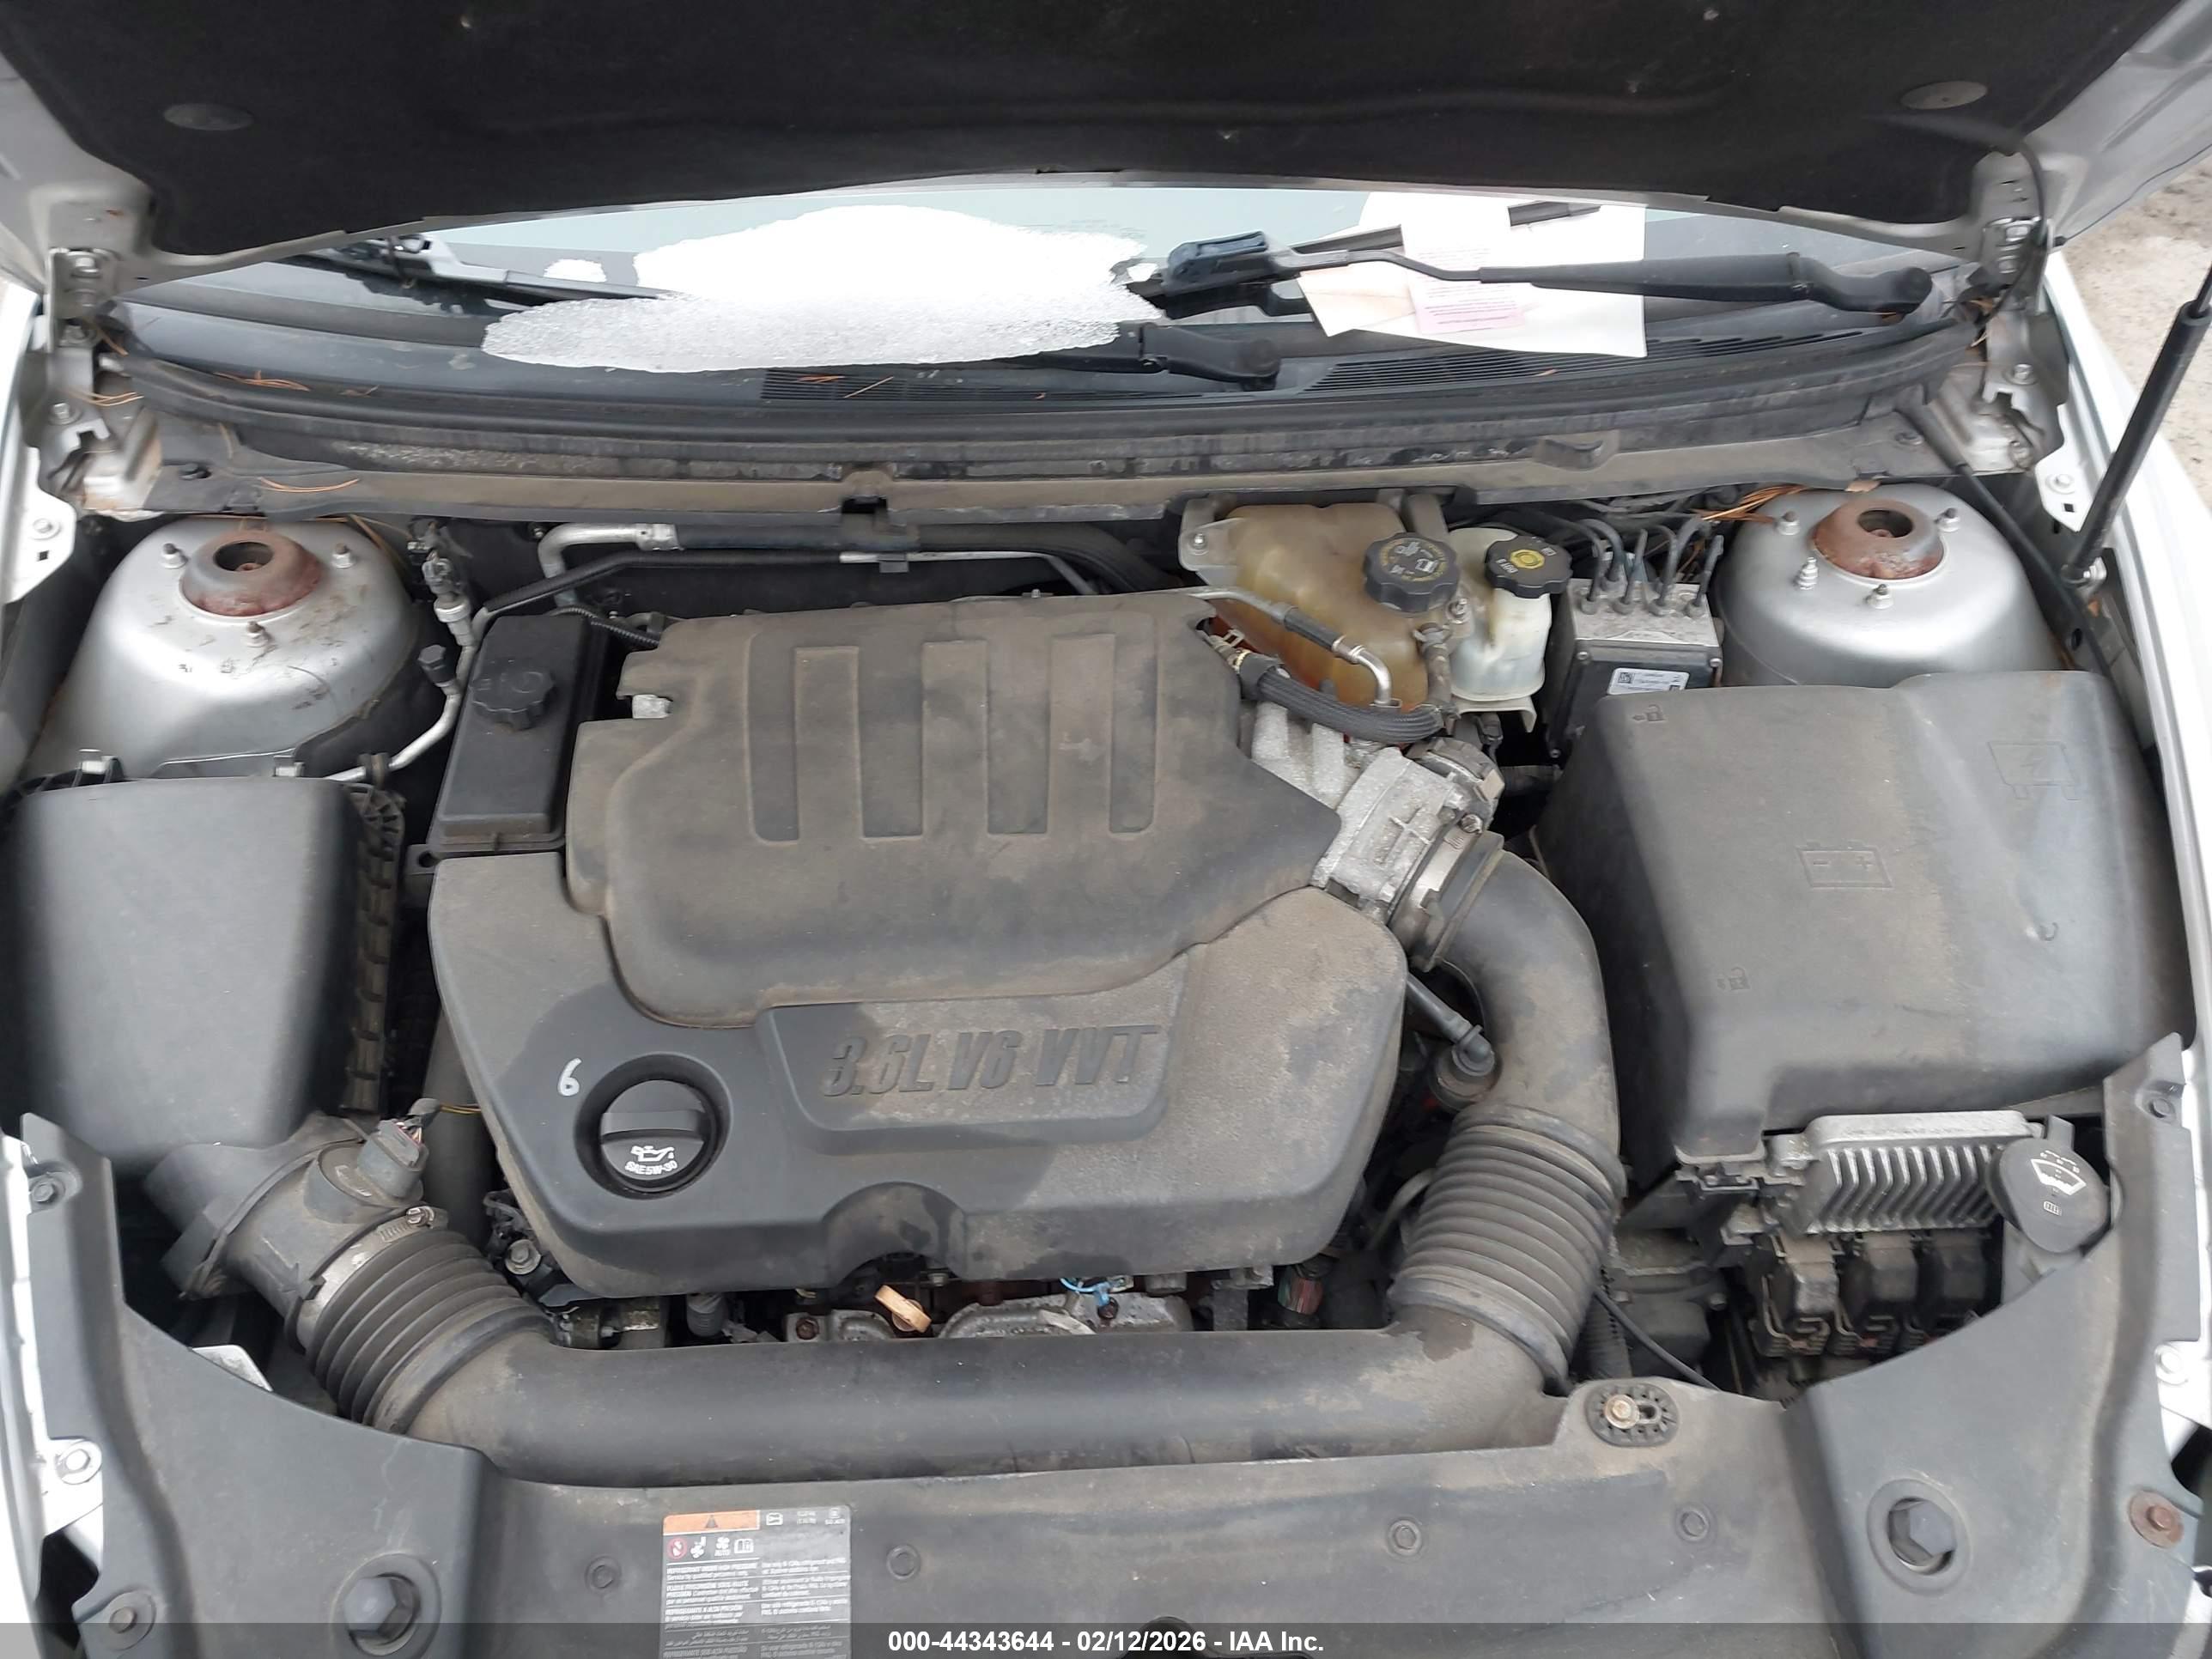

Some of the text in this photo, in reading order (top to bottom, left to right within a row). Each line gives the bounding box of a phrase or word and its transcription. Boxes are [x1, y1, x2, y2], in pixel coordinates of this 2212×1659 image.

[557, 1057, 582, 1097] 6
[823, 1024, 1160, 1097] 3.6L V6 VVT
